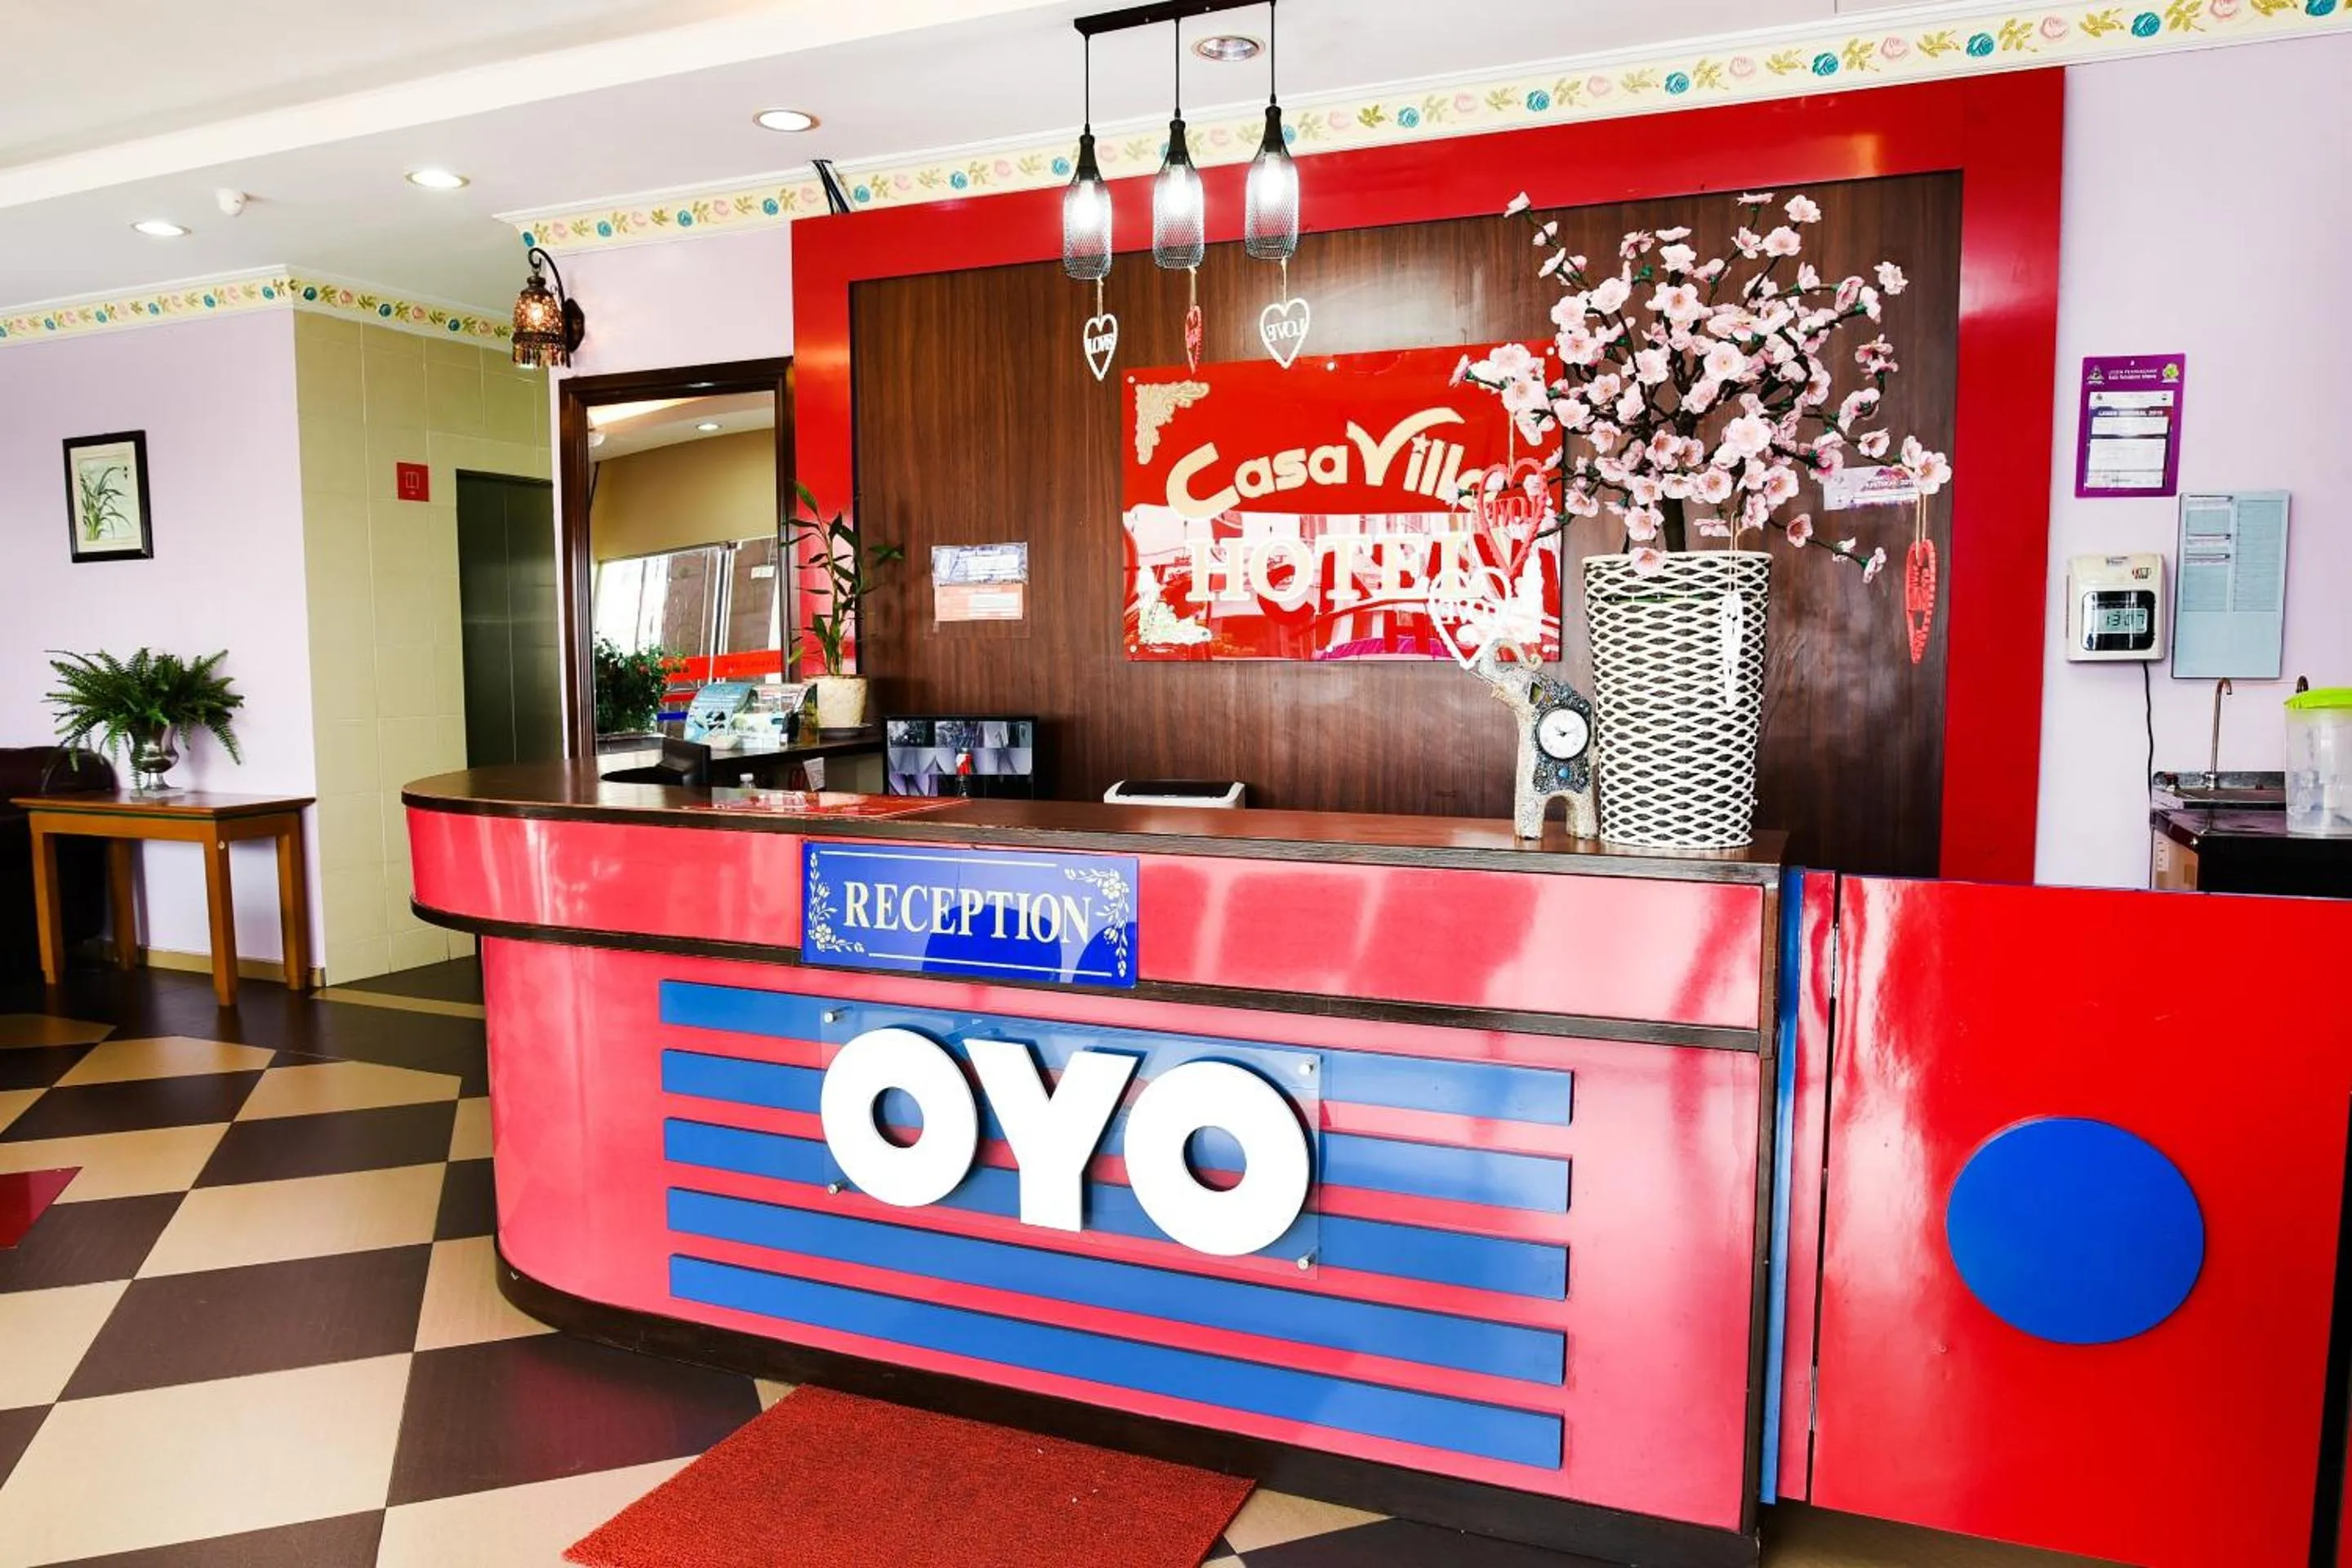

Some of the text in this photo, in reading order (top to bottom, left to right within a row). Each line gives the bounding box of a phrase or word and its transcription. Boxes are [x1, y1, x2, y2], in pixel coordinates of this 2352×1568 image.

[1186, 532, 1494, 602] HOTEL
[844, 881, 1091, 943] RECEPTION
[820, 1028, 1308, 1255] OYO
